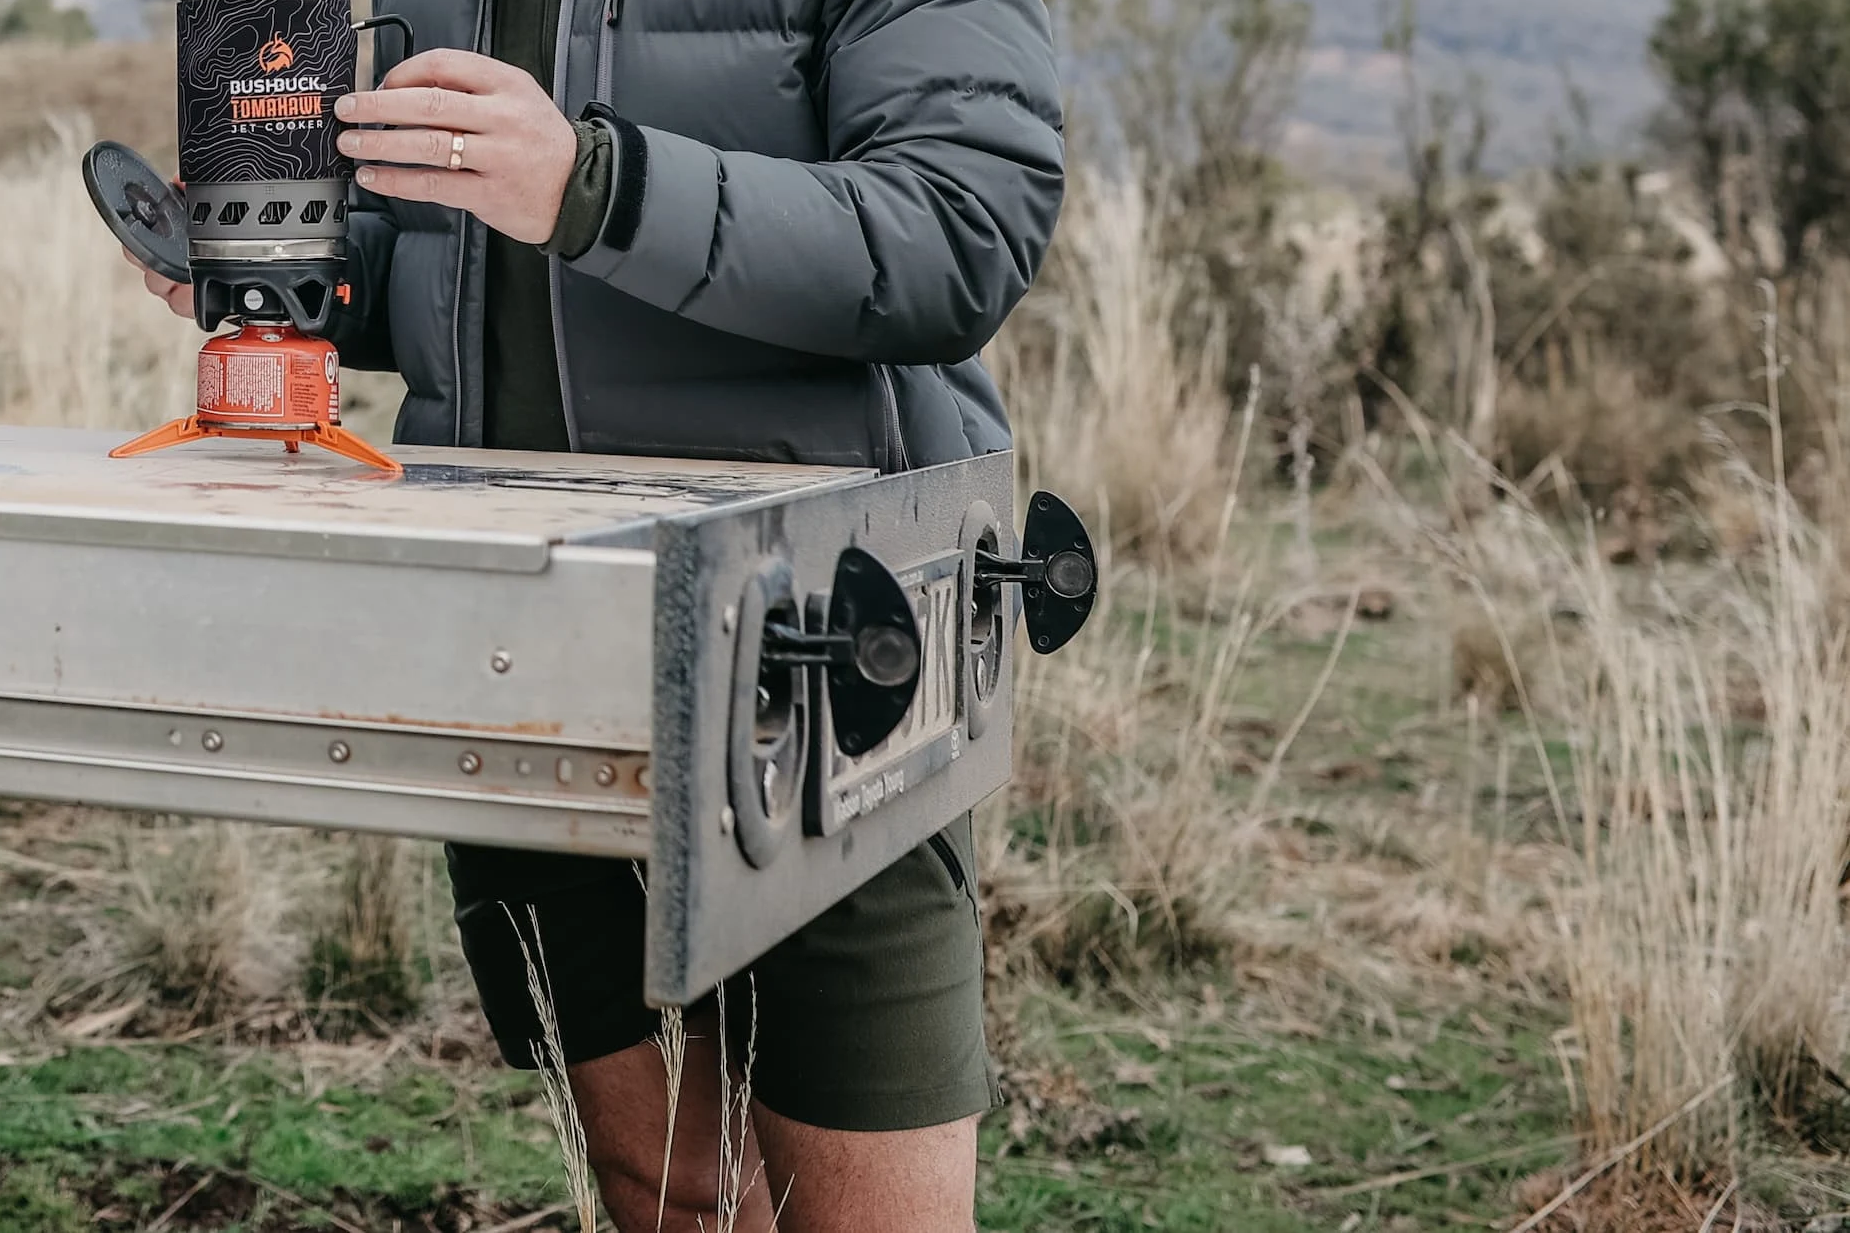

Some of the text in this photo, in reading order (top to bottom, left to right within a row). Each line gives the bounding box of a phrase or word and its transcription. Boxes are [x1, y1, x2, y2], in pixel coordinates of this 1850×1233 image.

[230, 76, 321, 95] BUSHBUCK
[230, 95, 322, 119] TOMAHAWK
[230, 119, 323, 134] JET COOKER
